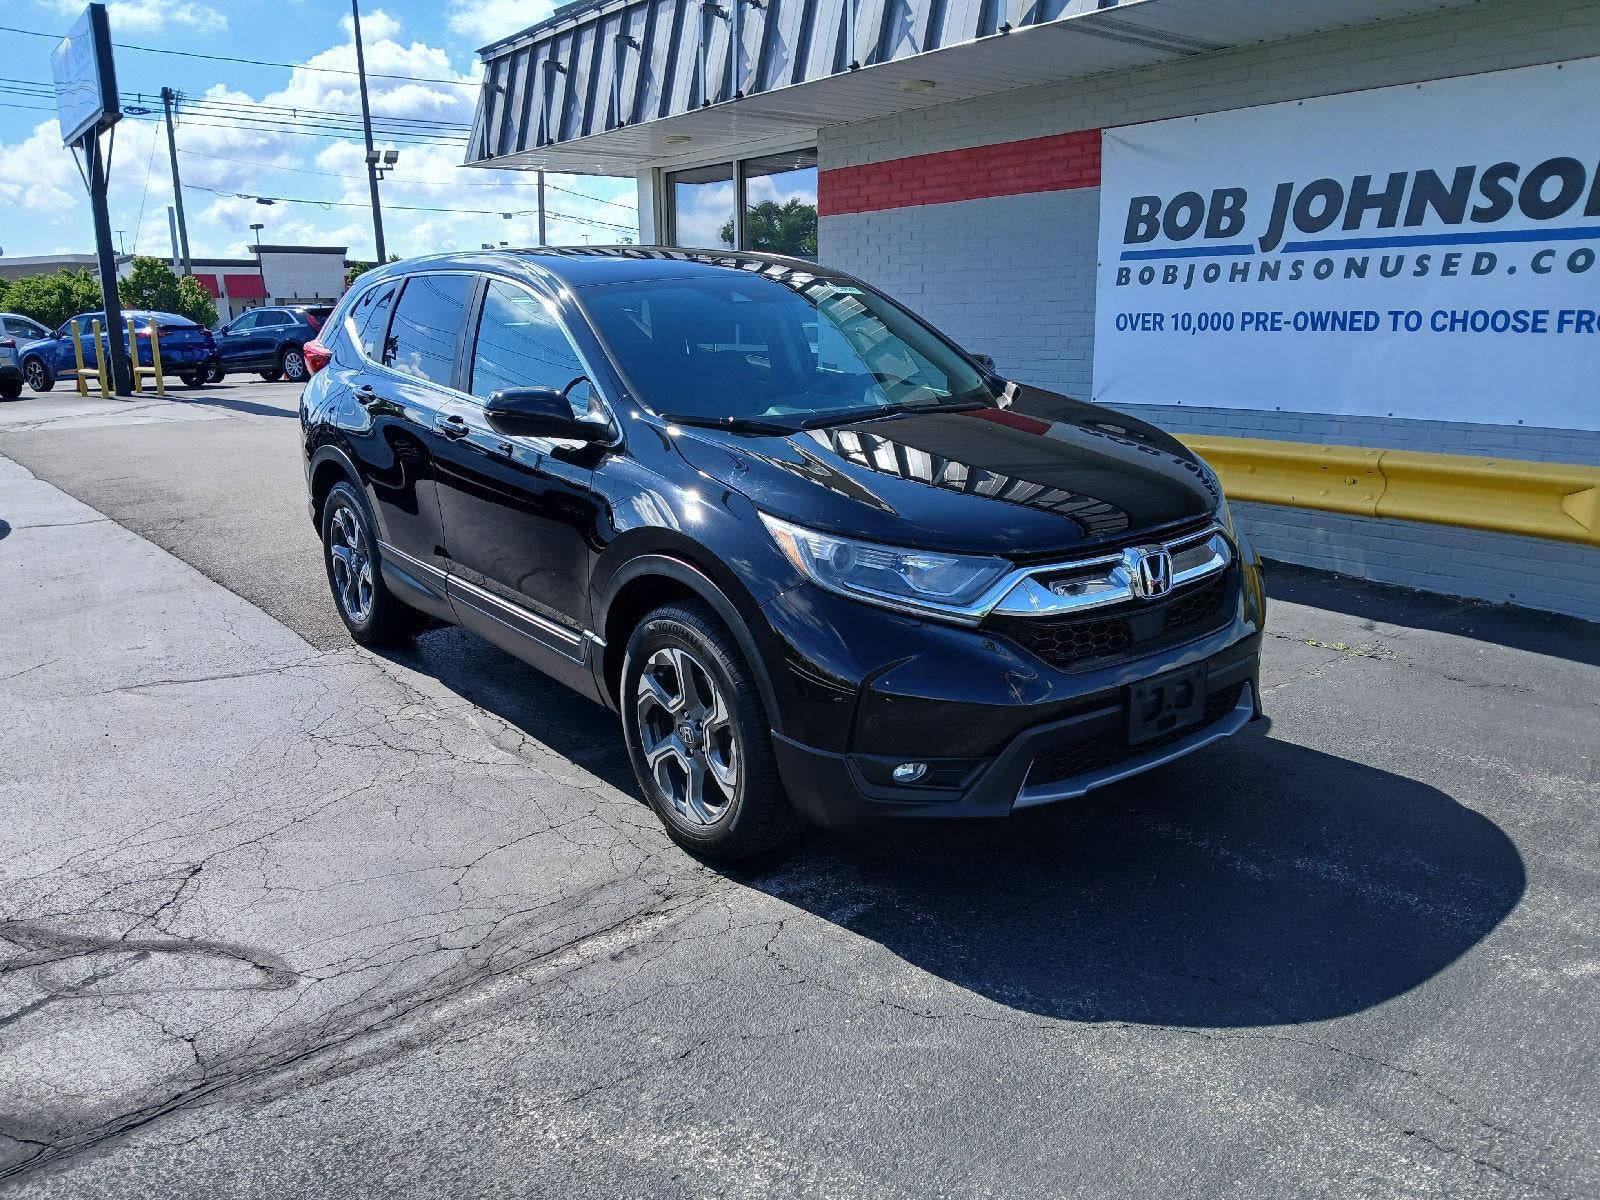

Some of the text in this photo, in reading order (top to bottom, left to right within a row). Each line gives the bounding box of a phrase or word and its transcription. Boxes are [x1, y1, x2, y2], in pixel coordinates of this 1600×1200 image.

[1123, 156, 1600, 253] BOB JOHNSO
[1115, 309, 1600, 335] OVER 10,000 PRE-OWNED TO CHOOSE FR
